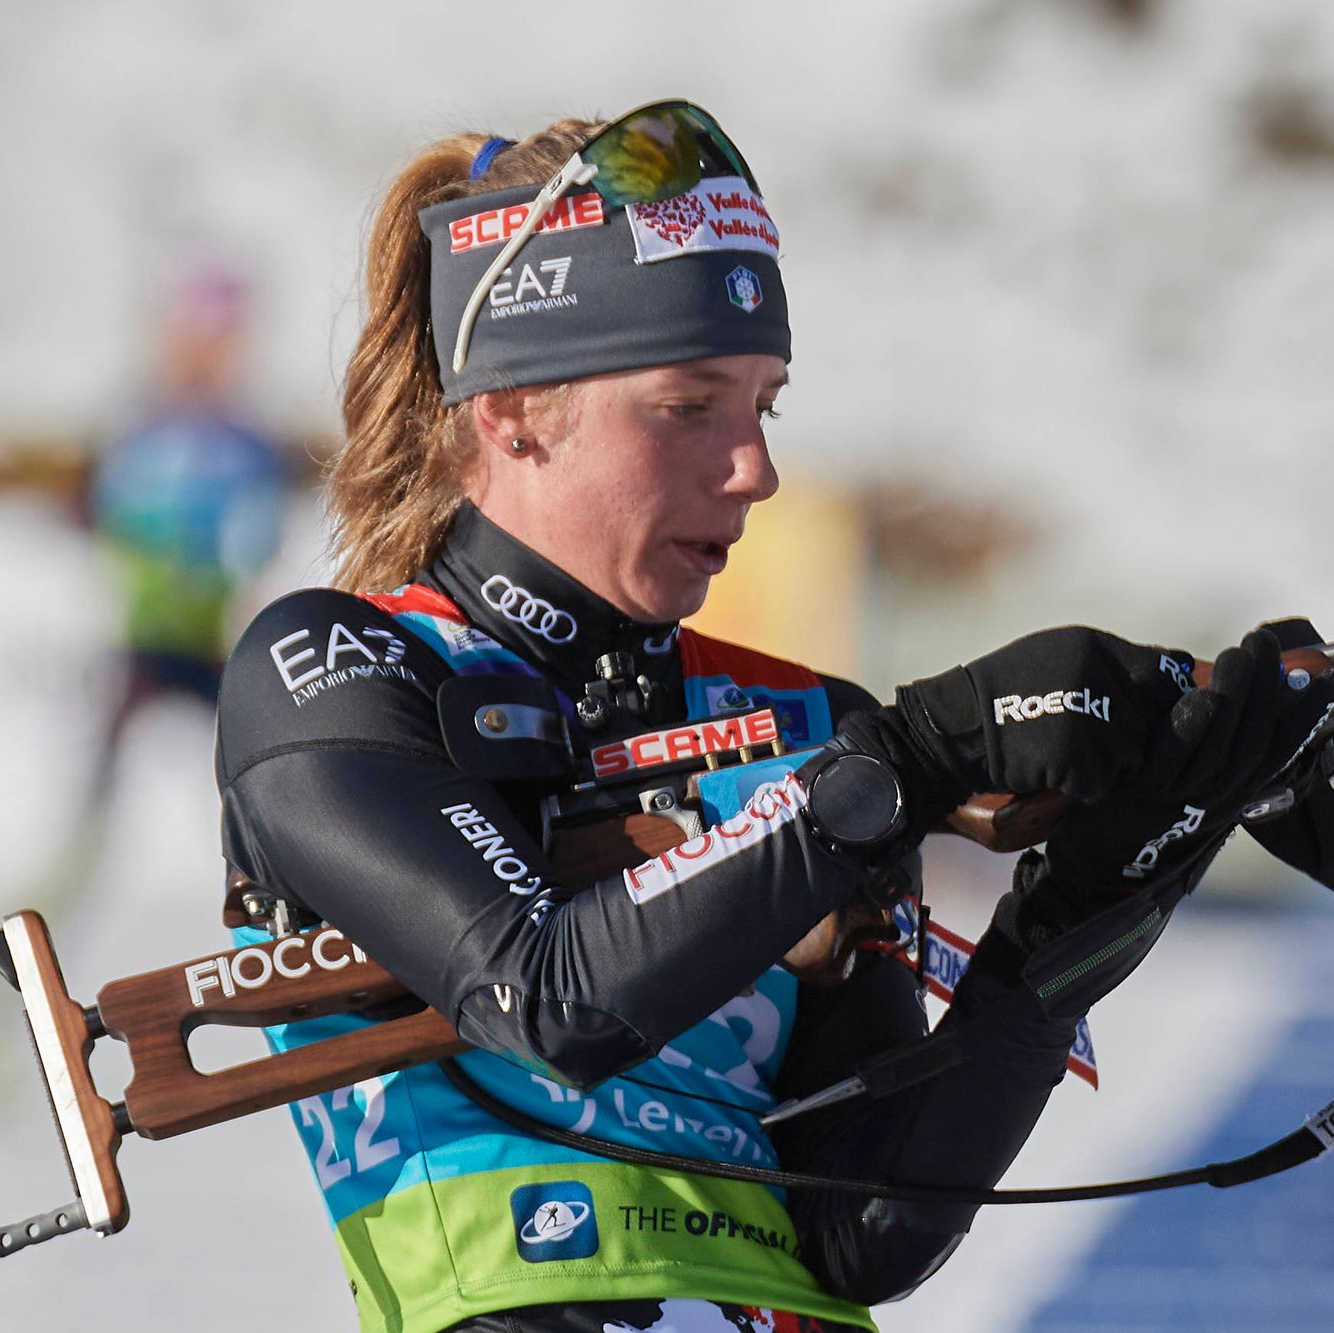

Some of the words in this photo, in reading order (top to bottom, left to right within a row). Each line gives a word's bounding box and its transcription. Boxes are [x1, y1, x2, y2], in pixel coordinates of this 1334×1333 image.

[489, 256, 572, 307] EA7
[270, 622, 406, 692] EA7
[291, 665, 355, 708] EMPORIO
[593, 710, 777, 777] SCAME
[441, 803, 547, 910] CONERI
[184, 929, 367, 1008] FIOCC
[297, 1077, 401, 1191] 22
[618, 1205, 677, 1233] THE
